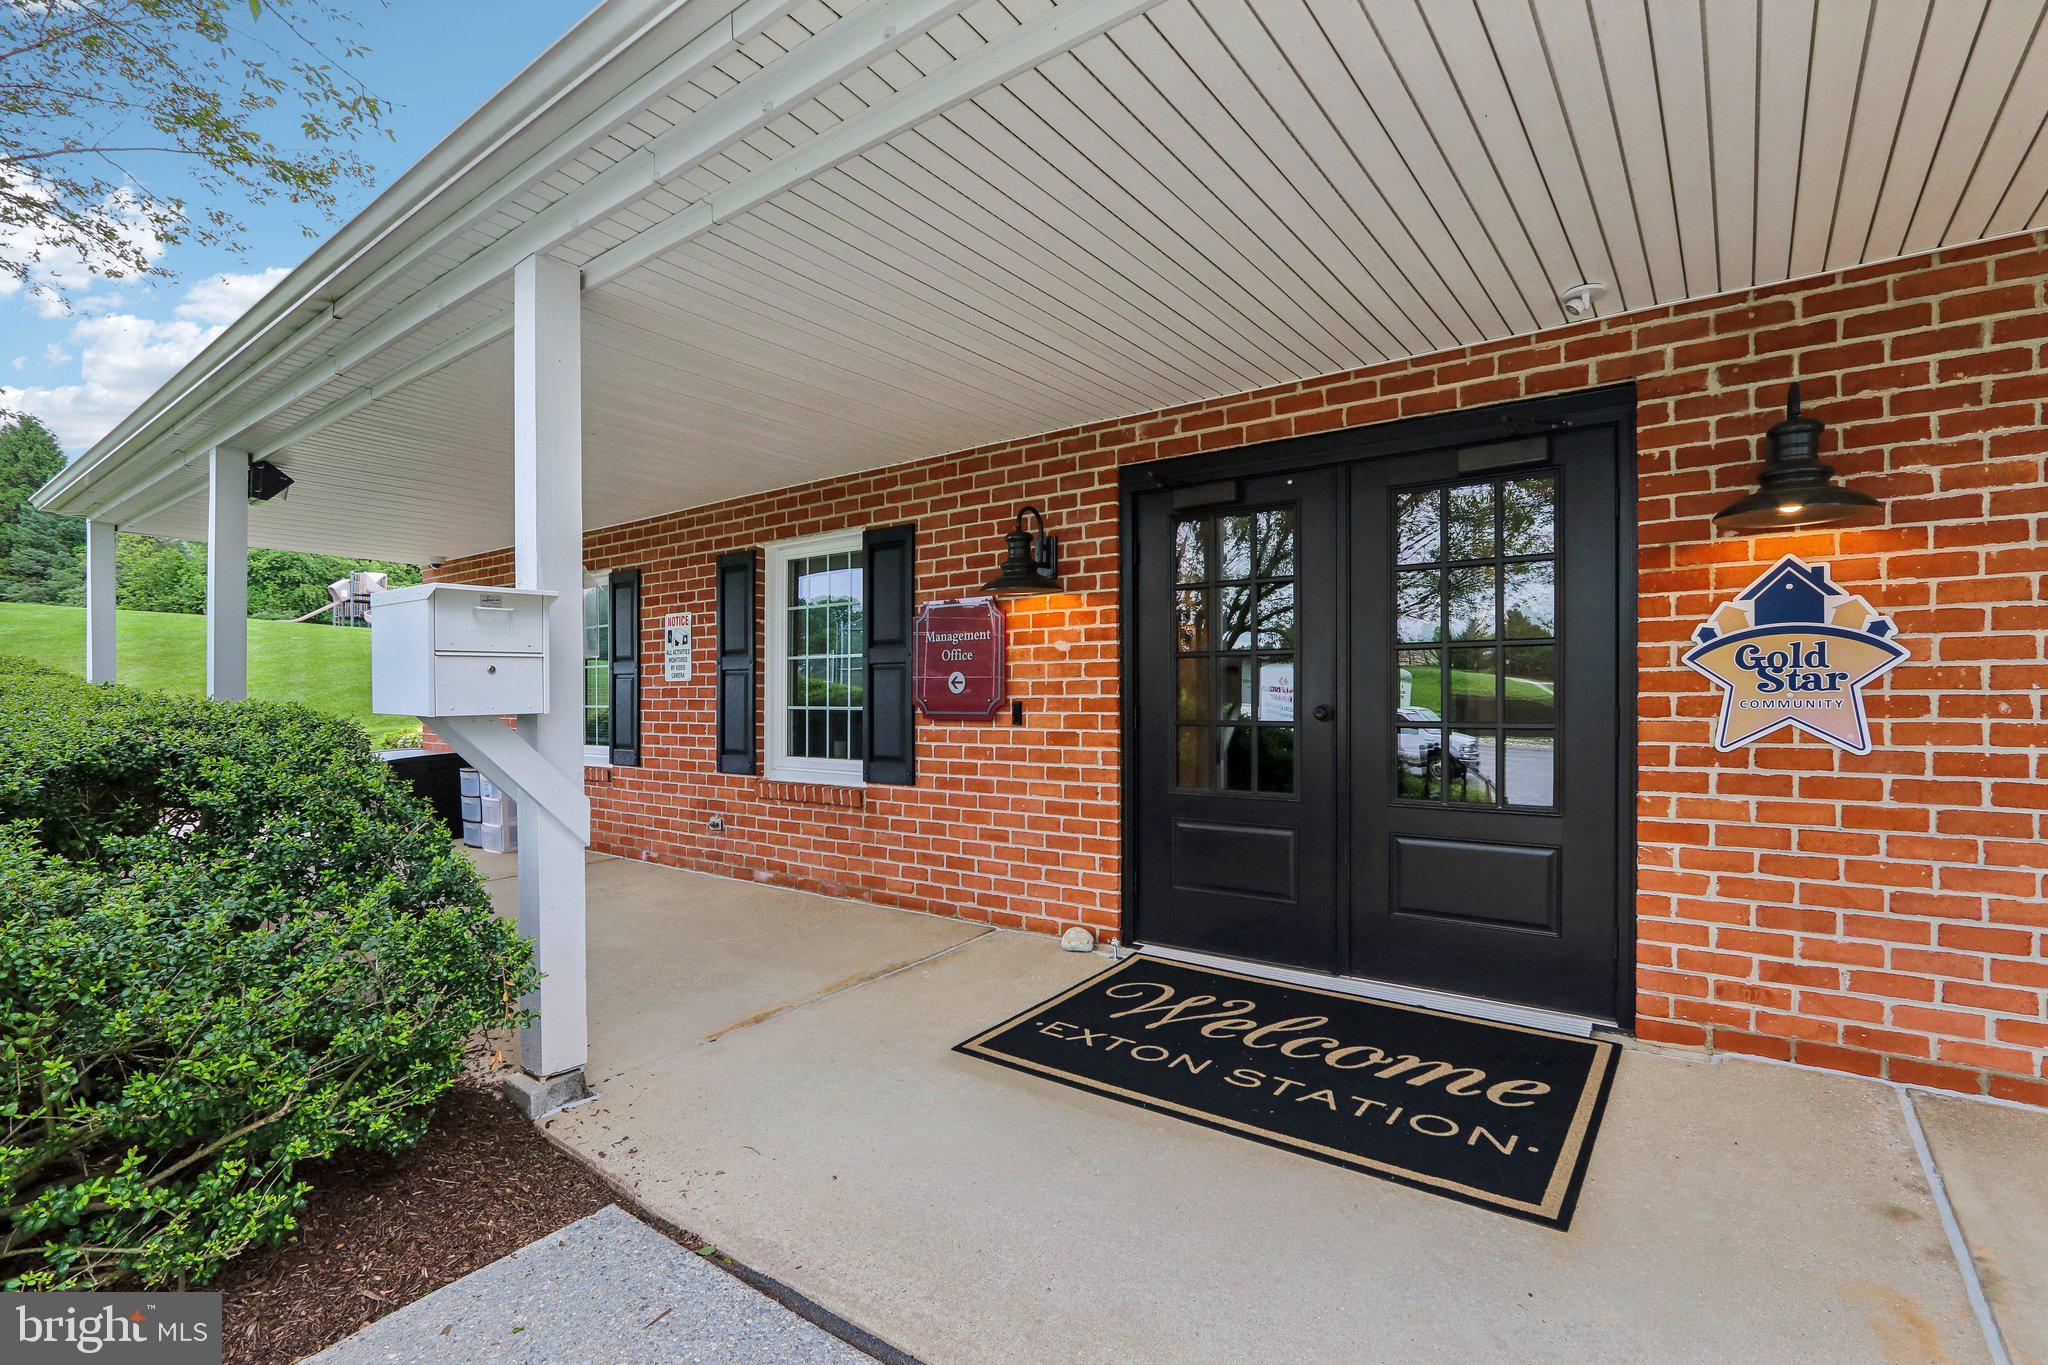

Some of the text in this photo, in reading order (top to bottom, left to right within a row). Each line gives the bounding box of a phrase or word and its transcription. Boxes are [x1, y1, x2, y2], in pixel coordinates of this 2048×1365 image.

[667, 615, 689, 627] NOTICE
[926, 629, 991, 645] Management
[941, 649, 973, 661] Office
[1734, 640, 1831, 672] Gold
[1756, 667, 1849, 693] Star
[1739, 698, 1844, 709] COMMUNITY
[1105, 982, 1551, 1107] Welcome
[1038, 1021, 1519, 1155] EXTON STATION
